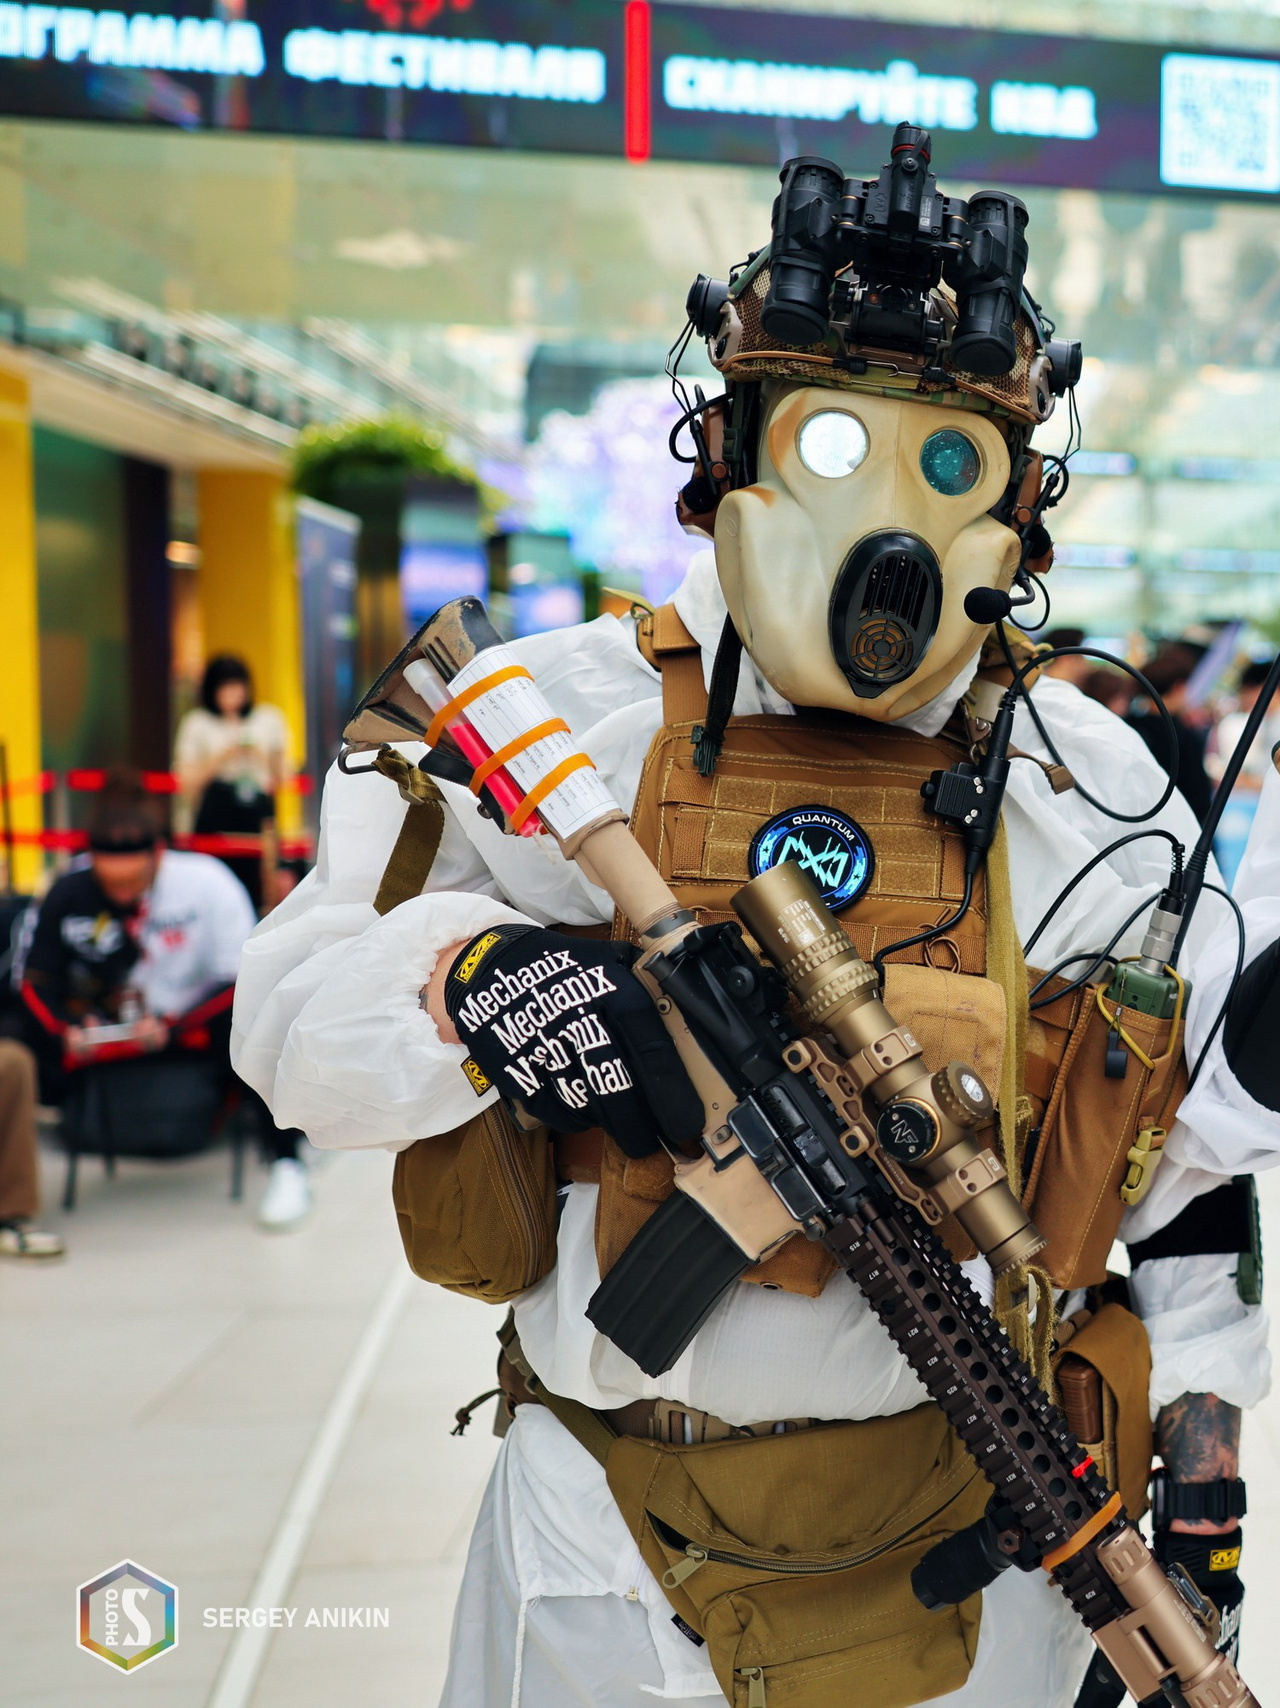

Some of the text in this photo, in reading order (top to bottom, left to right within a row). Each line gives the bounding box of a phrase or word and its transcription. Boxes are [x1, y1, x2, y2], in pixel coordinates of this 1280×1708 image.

[285, 29, 604, 102] ФЕСТИВАЛЯ
[792, 814, 855, 841] QUANTUM
[458, 950, 579, 1033] Mechanix
[491, 964, 618, 1055] Mechanix
